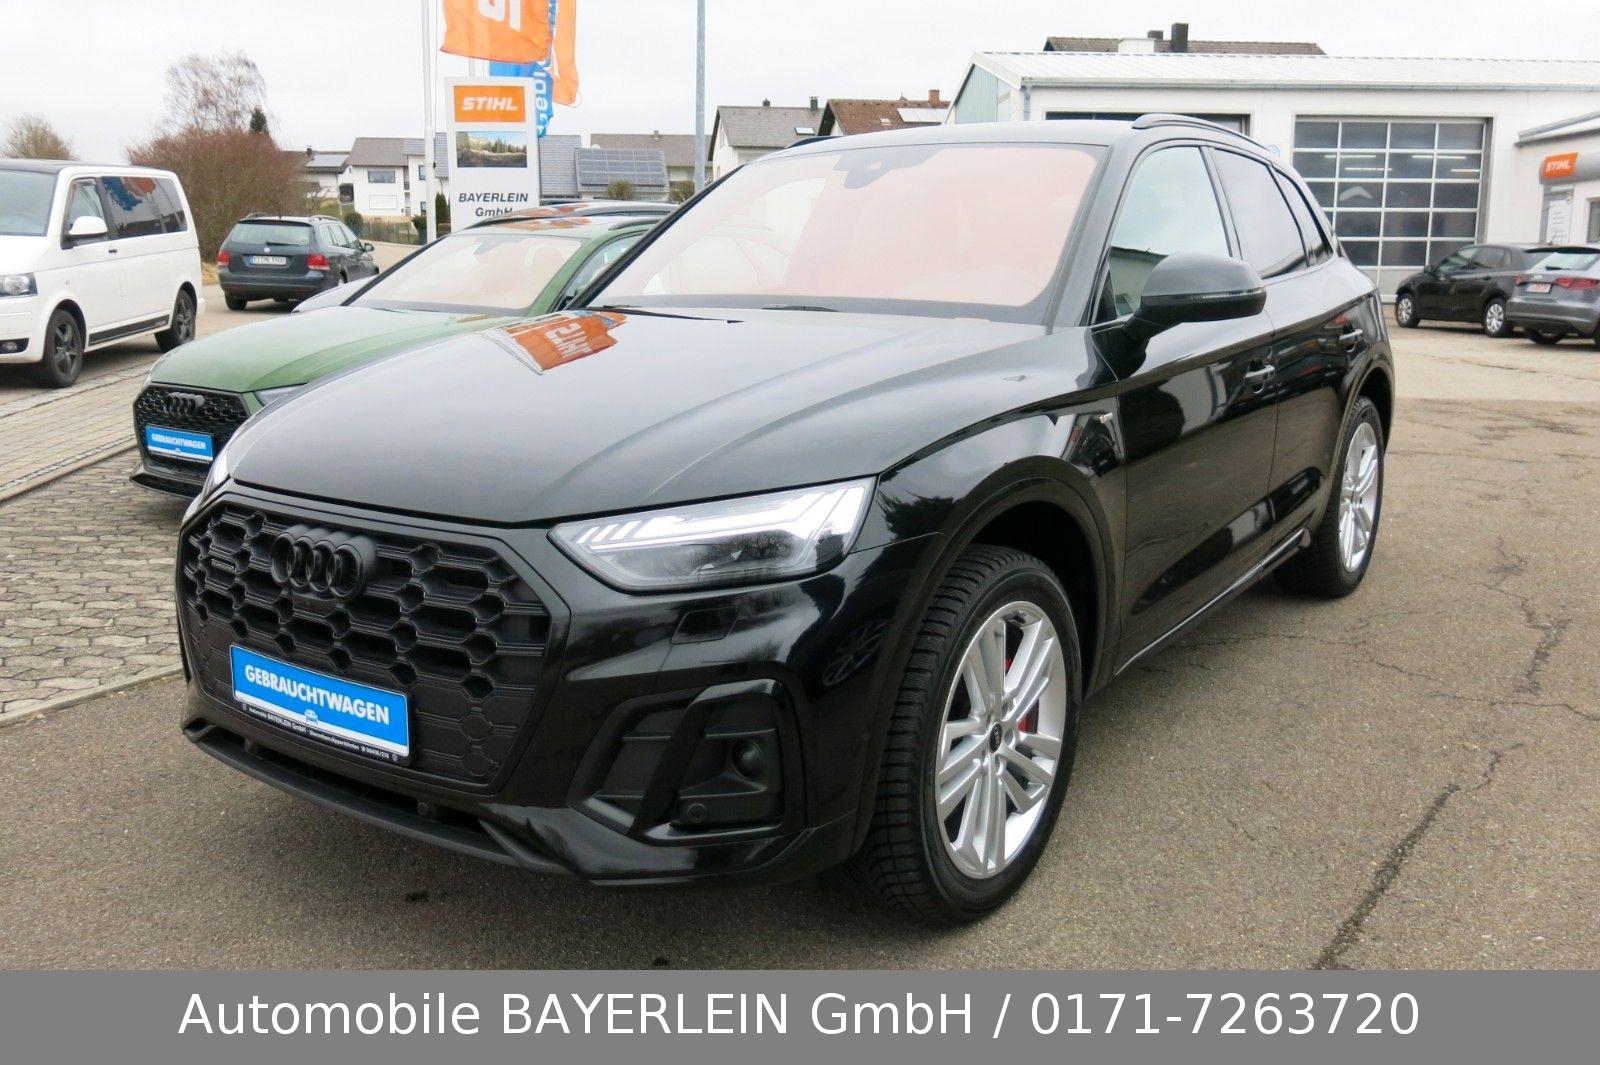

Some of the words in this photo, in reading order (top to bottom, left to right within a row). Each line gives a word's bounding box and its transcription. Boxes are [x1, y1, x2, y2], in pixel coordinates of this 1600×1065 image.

[461, 96, 519, 111] STIHL
[1545, 160, 1570, 172] STIHL
[458, 192, 529, 203] BAYERLEIN
[151, 433, 207, 450] GEBRAUCHTWAGEN
[244, 664, 390, 725] GEBRAUCHTWAGEN
